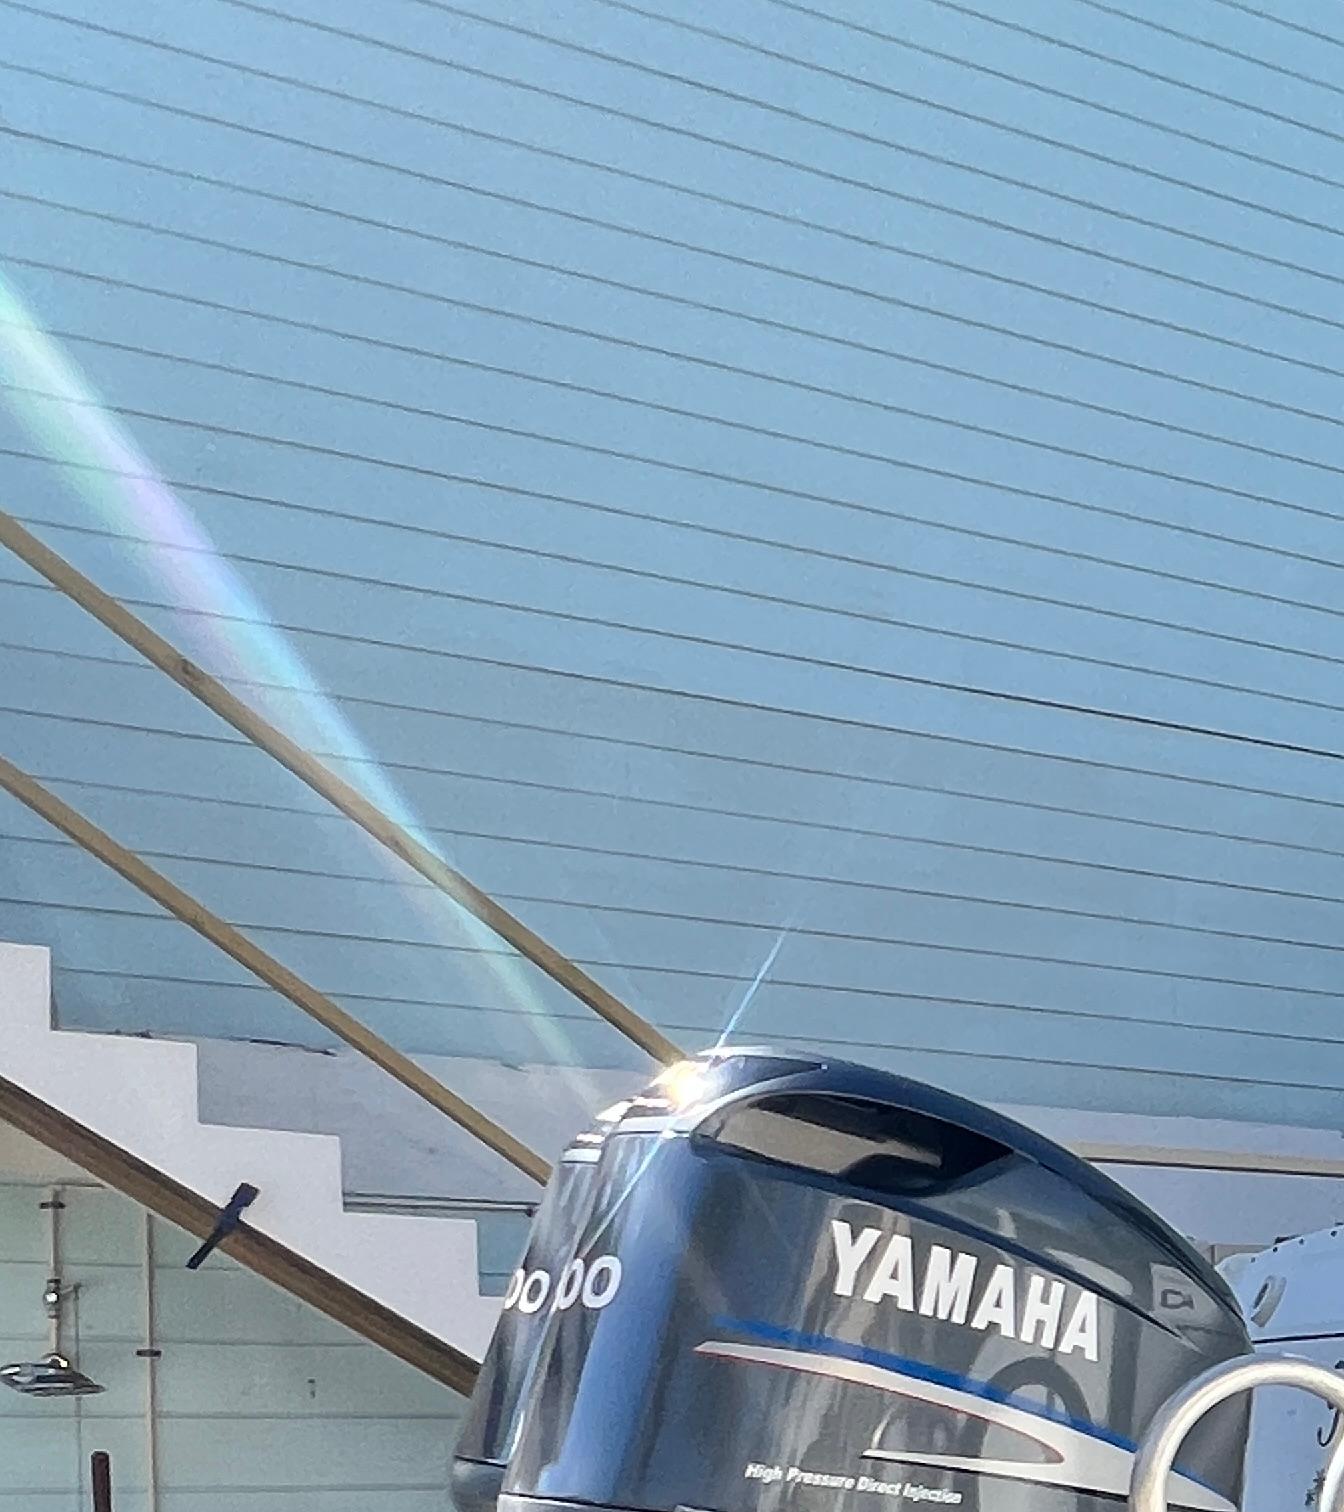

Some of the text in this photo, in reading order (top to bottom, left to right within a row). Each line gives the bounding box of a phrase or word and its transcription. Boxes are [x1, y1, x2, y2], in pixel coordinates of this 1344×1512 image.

[831, 1219, 1099, 1362] YAMAHA
[744, 1461, 964, 1504] High Pressure Direct Injection
